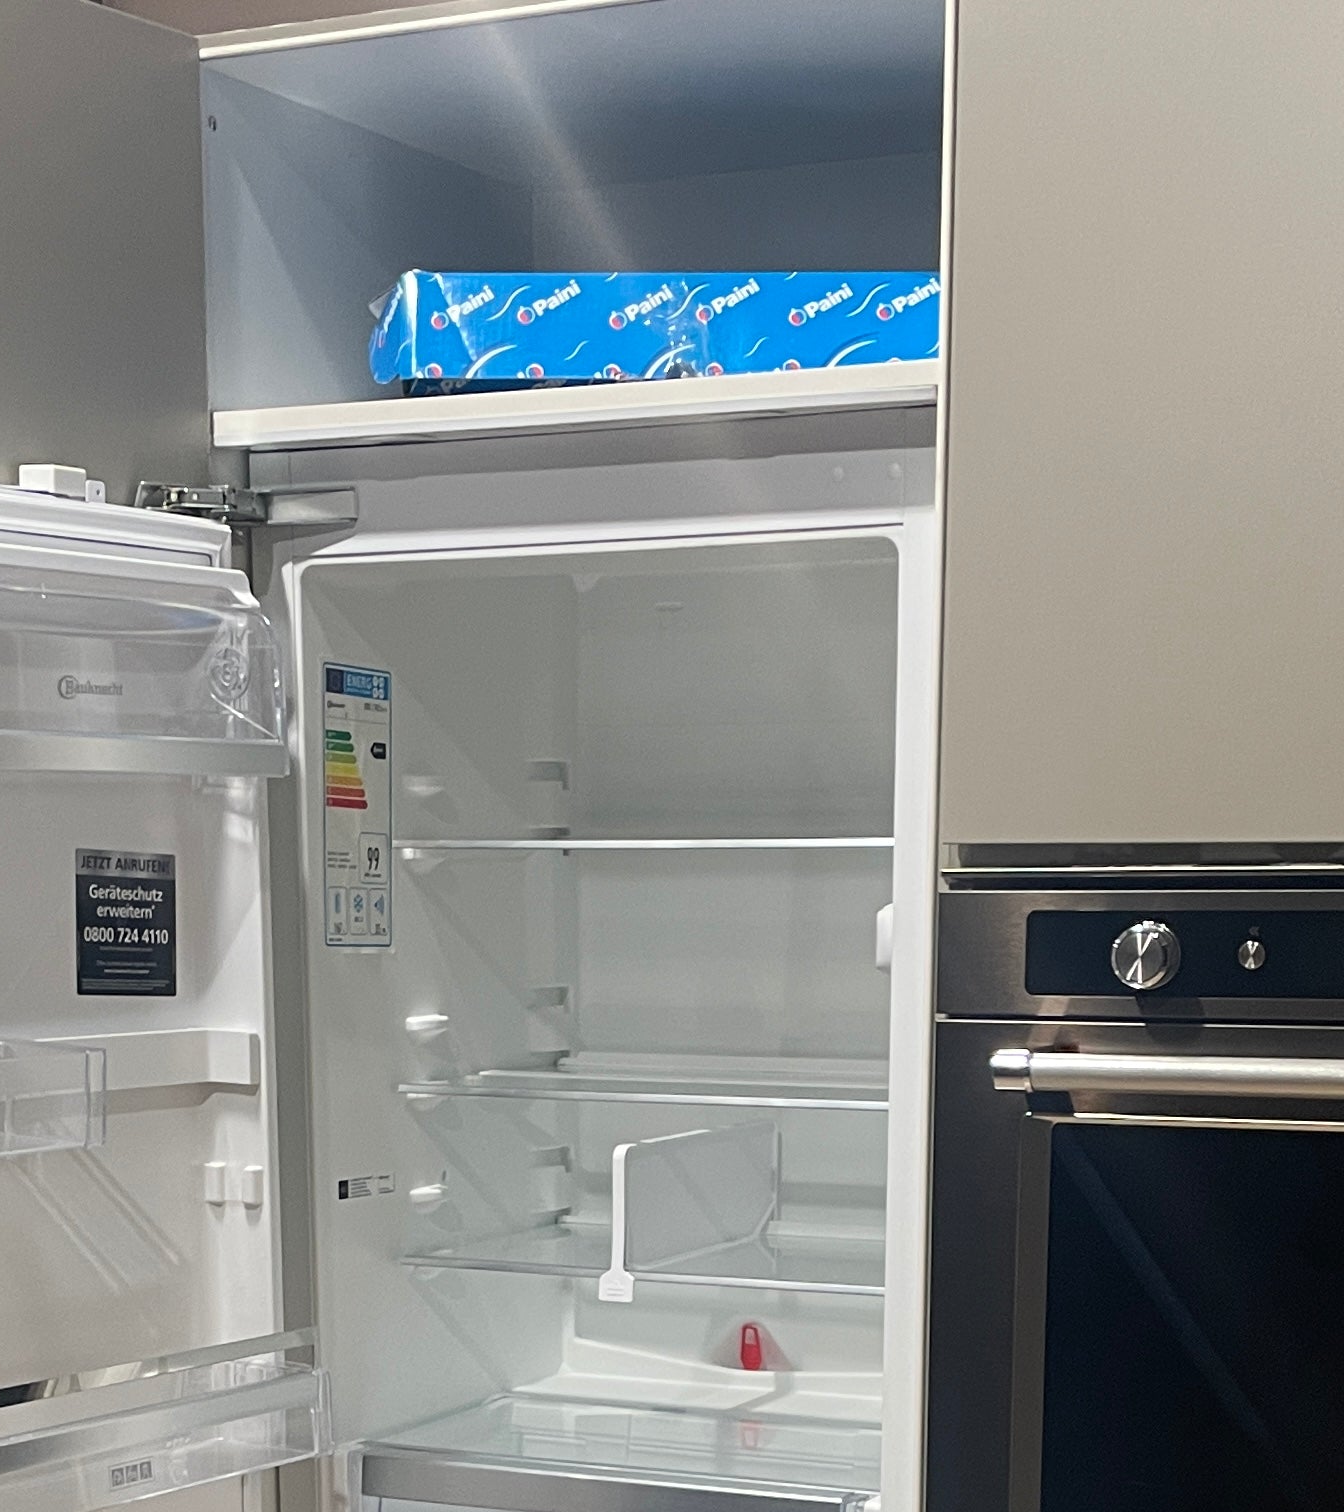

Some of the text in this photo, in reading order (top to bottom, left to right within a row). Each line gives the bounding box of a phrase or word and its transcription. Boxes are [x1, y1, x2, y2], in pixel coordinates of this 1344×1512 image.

[446, 284, 495, 322] Paini
[533, 279, 581, 316] Paini
[624, 283, 674, 321] Paini
[711, 278, 761, 314] Paini
[803, 282, 853, 318] Paini
[892, 277, 941, 313] Paini
[81, 855, 111, 870] JETZT
[367, 846, 380, 871] 99
[89, 884, 163, 902] Geräteschutz
[84, 926, 169, 944] 0800 724 4110
